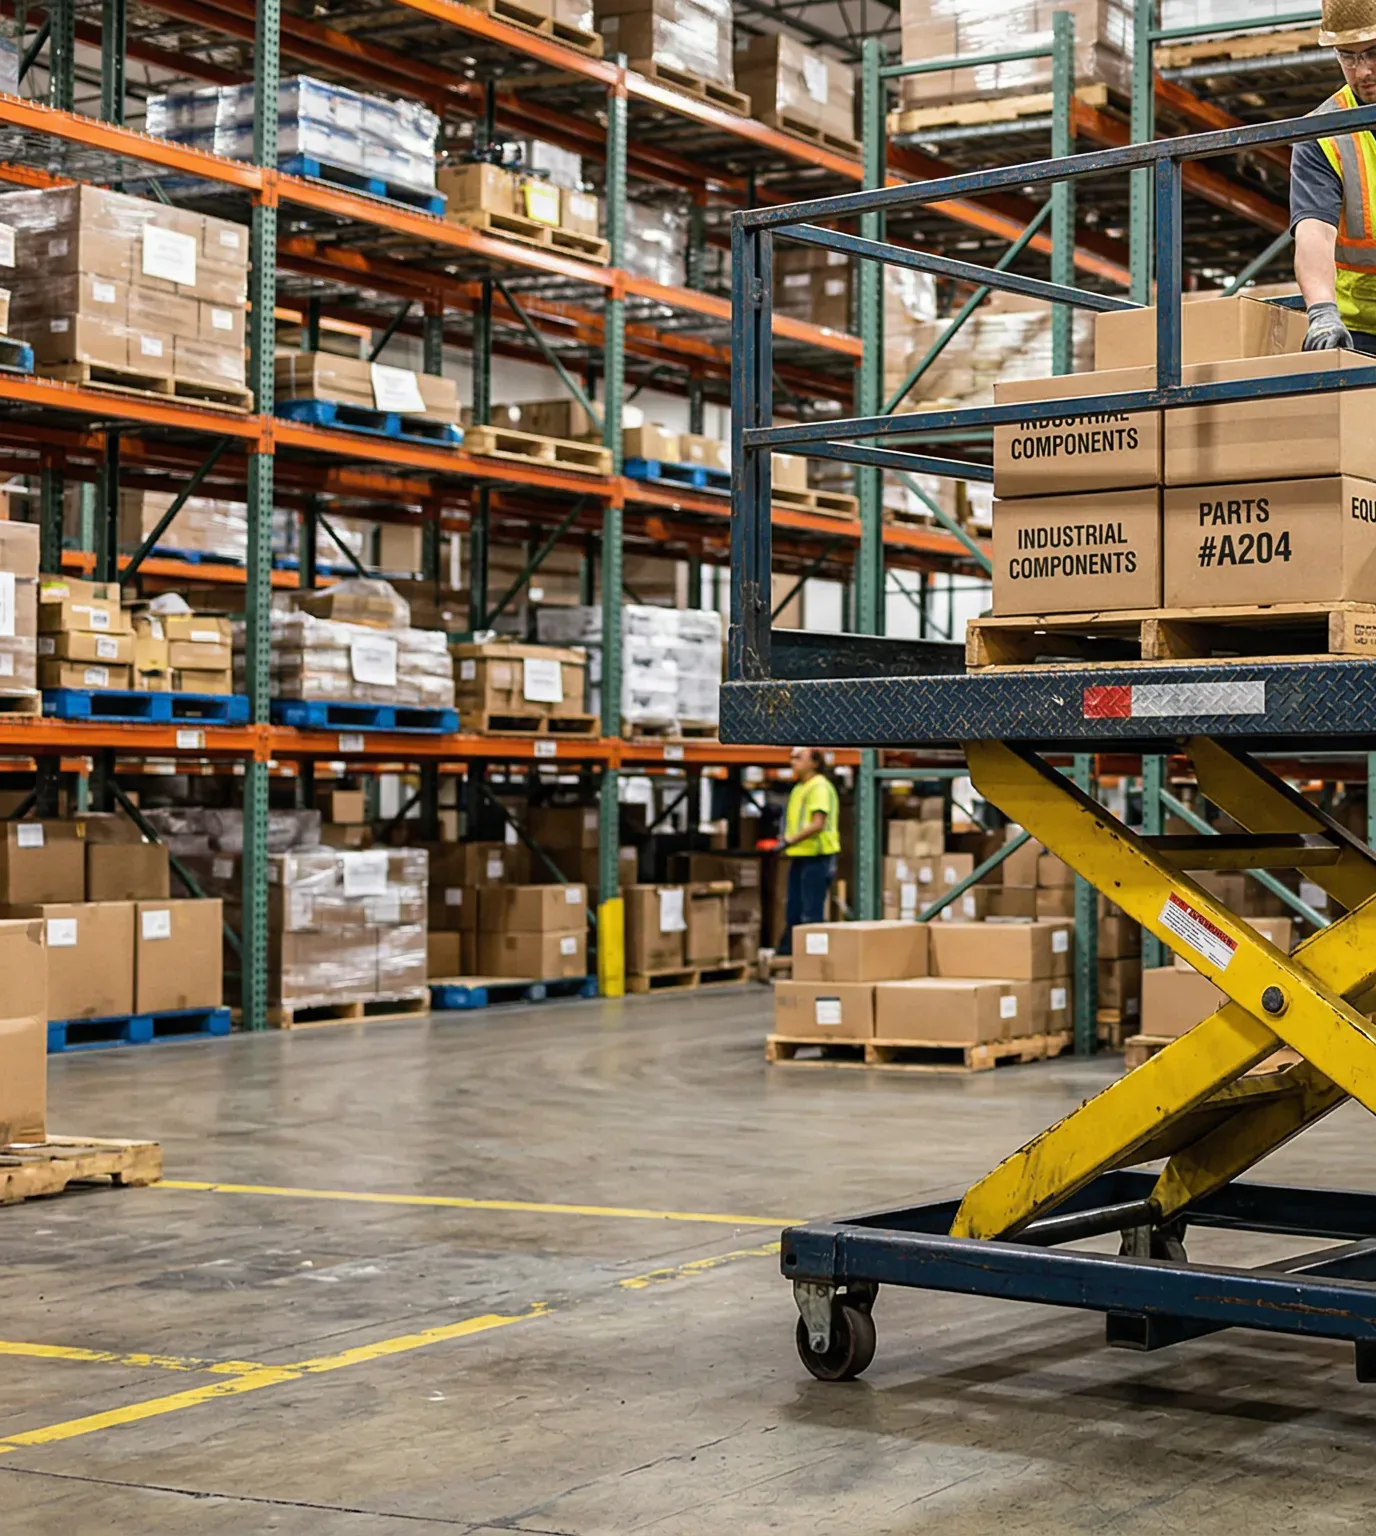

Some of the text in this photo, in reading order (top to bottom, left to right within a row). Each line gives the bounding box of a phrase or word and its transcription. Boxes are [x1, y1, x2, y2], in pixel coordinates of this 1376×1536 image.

[1011, 427, 1138, 460] COMPONENTS
[1199, 498, 1269, 527] PARTS
[1018, 522, 1128, 550] INDUSTRIAL
[1198, 531, 1292, 567] #A204
[1009, 551, 1137, 580] COMPONENTS
